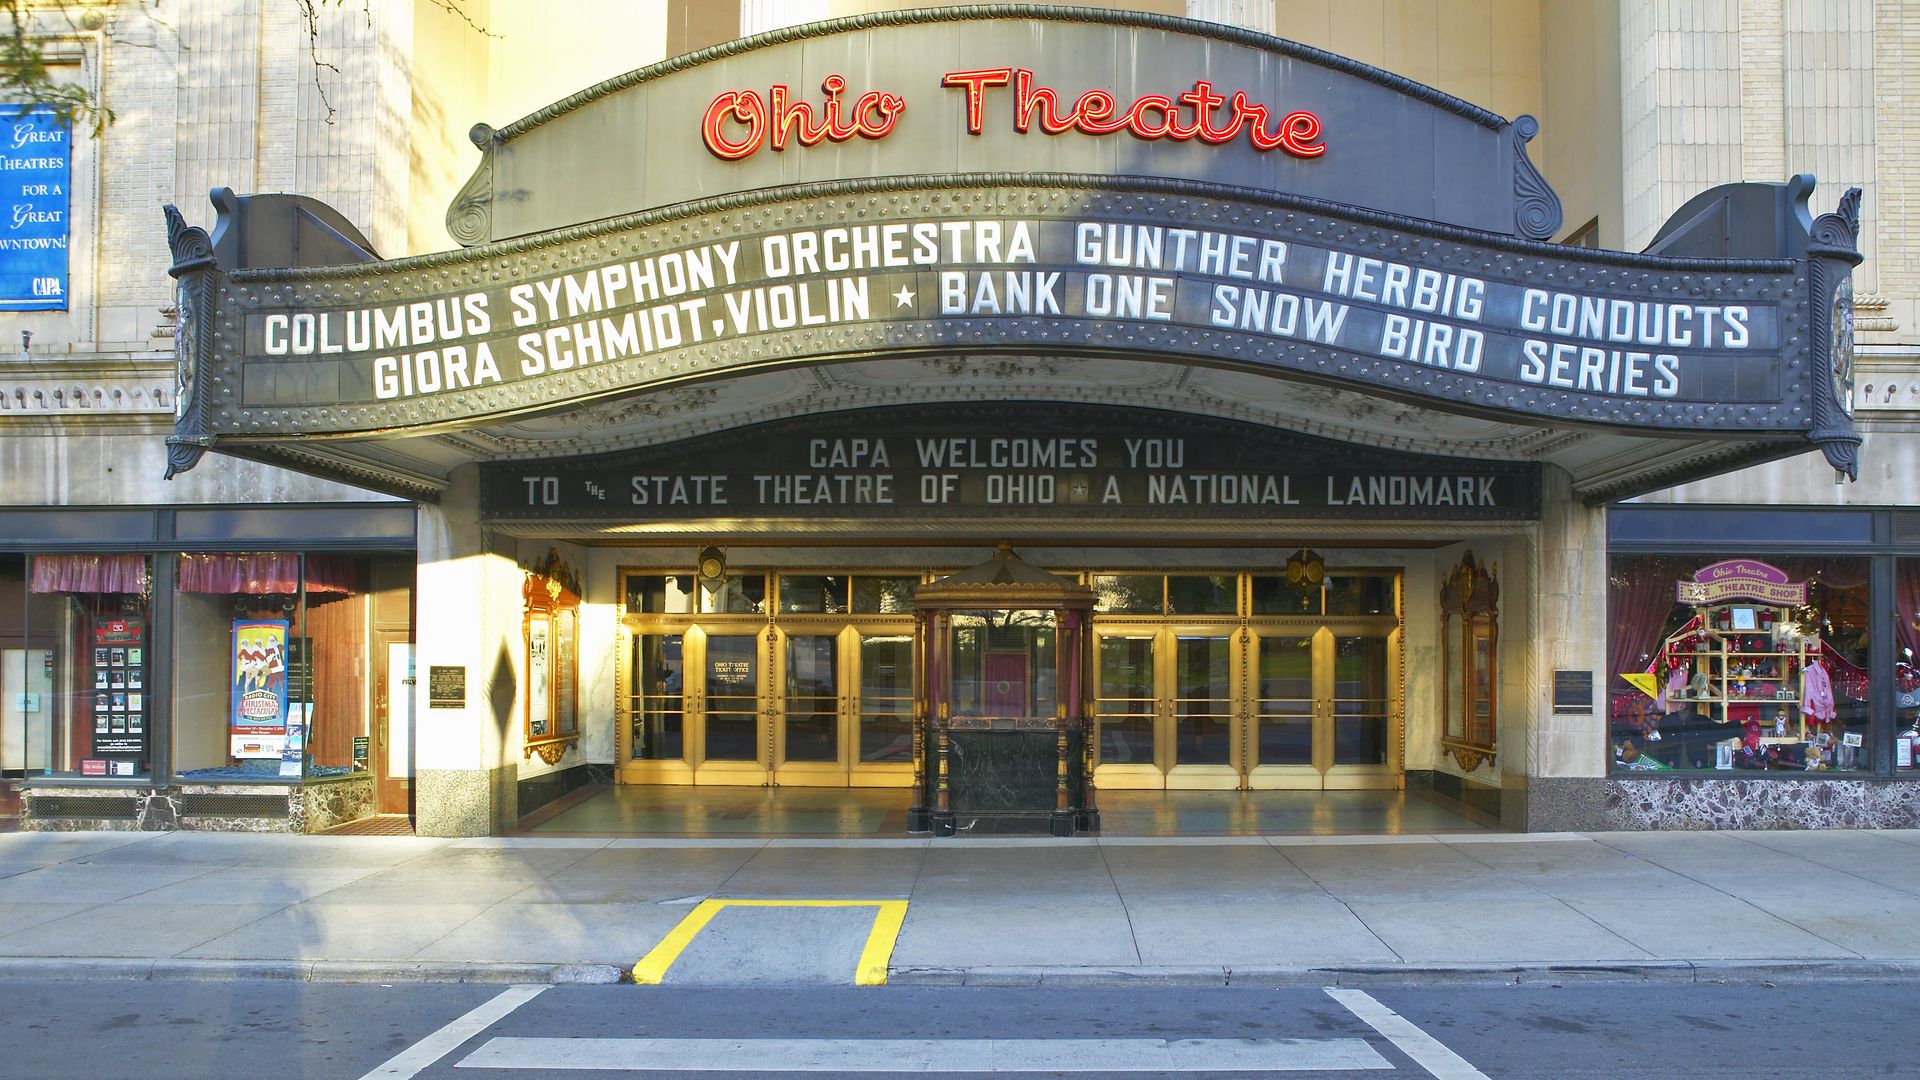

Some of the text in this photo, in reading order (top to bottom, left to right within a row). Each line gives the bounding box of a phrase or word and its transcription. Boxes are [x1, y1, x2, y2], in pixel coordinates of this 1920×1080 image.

[702, 68, 1327, 160] Ohio Theatre
[22, 184, 62, 196] FOR A
[33, 277, 64, 296] CAPA
[265, 220, 1749, 356] COLUMBUS SYMPHONY ORCHESTRA GUNTHER HERBIG CONDUCTS
[373, 342, 502, 400] GIORA
[939, 270, 1062, 316] BANK
[1085, 273, 1174, 321] ONE
[1211, 284, 1350, 345] SNOW
[1380, 313, 1484, 374] BIRD
[1519, 339, 1679, 398] SERIES
[809, 438, 1185, 469] CAPA WELCOMES YOU
[523, 474, 1496, 507] TO THE STATE THEATRE OF OHIO A NATIONAL LANDMARK
[1712, 565, 1768, 579] Ohio Theatre
[1718, 583, 1765, 594] THEATRE
[1770, 588, 1797, 598] SHOP
